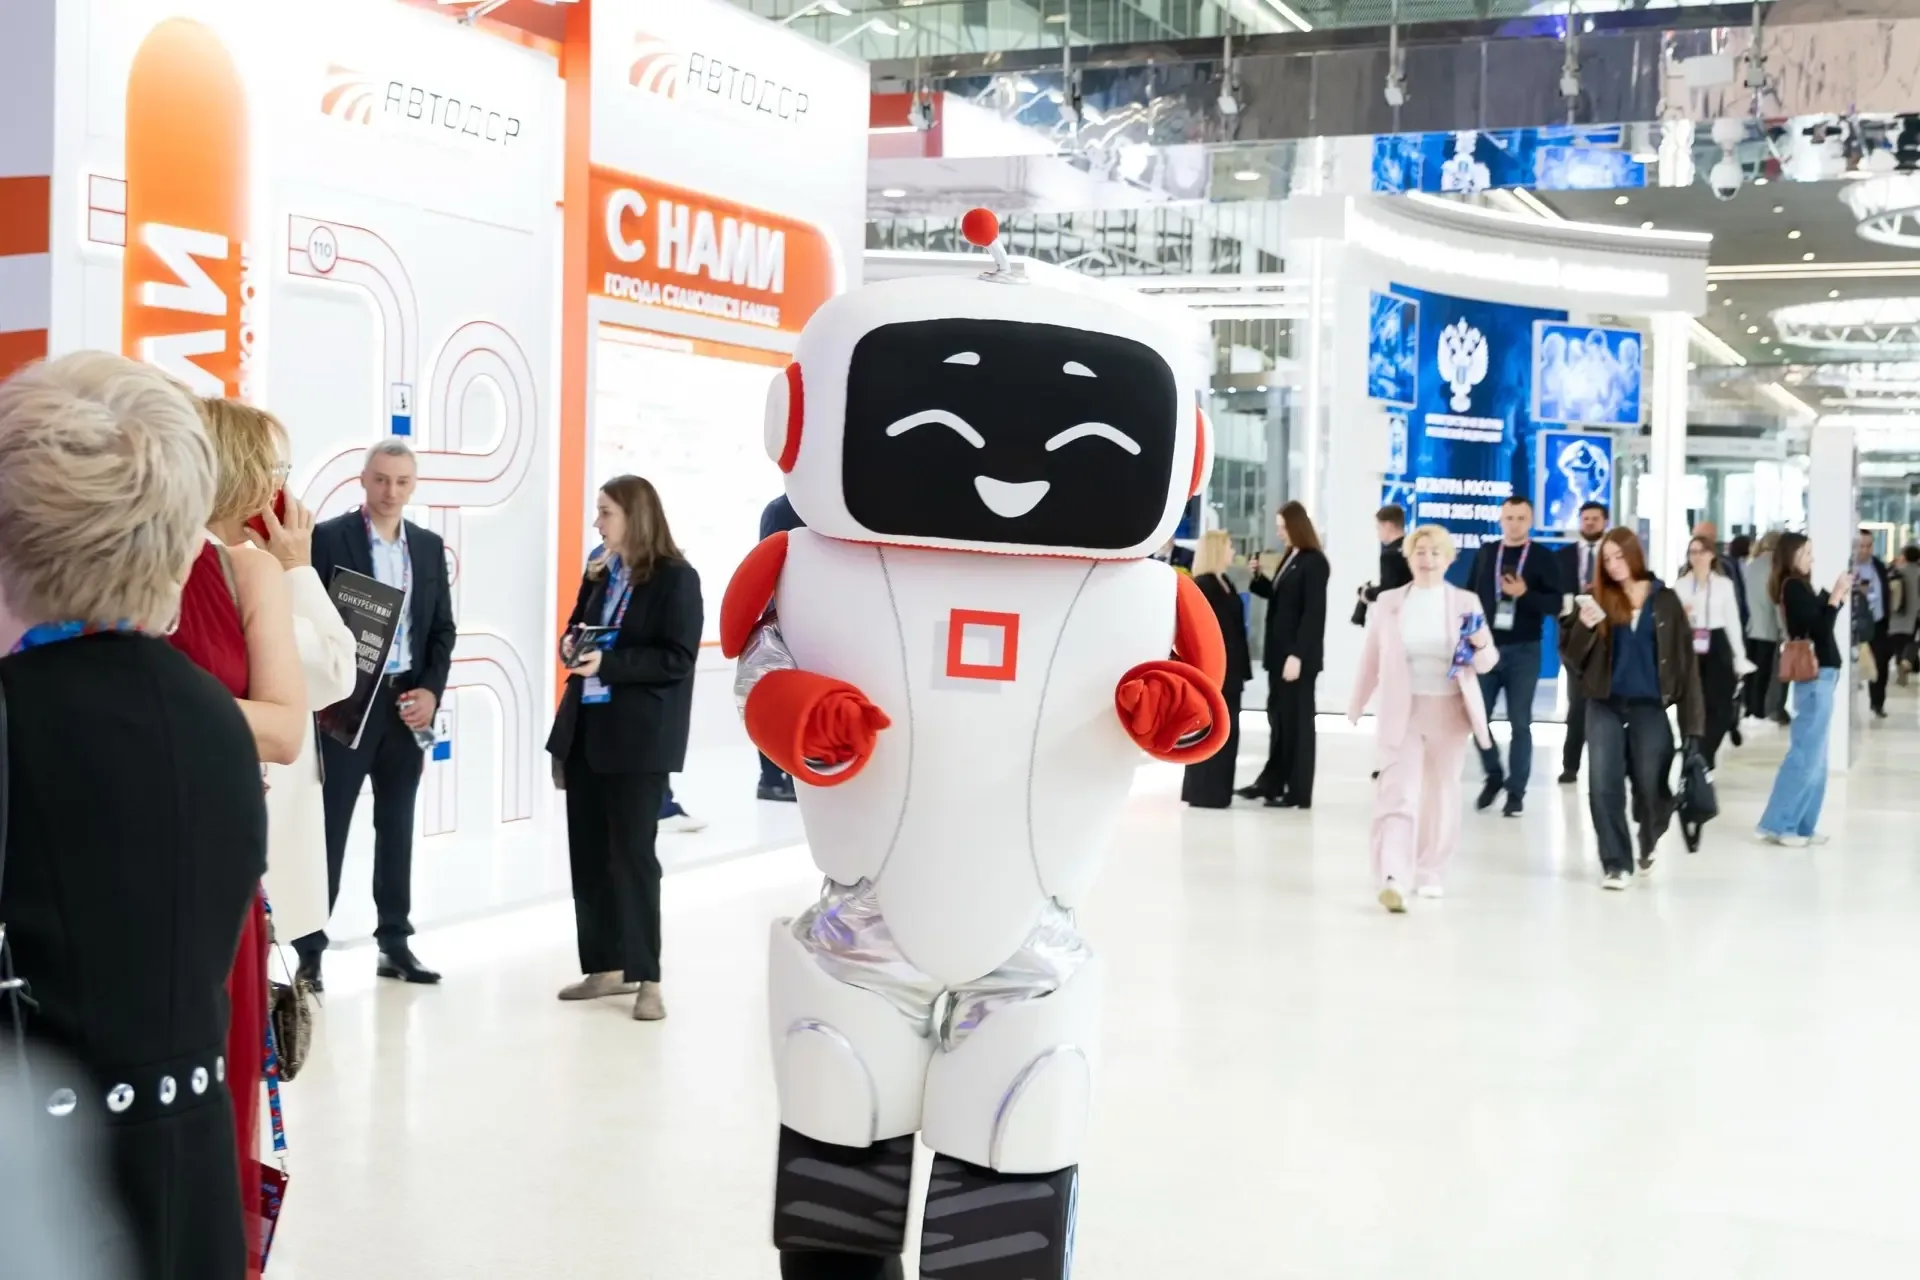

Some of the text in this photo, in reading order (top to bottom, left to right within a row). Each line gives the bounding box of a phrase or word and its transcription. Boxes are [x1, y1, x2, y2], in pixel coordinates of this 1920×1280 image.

[313, 240, 333, 258] 110
[605, 188, 786, 294] С НАМИ
[604, 271, 661, 304] ГОРОДА
